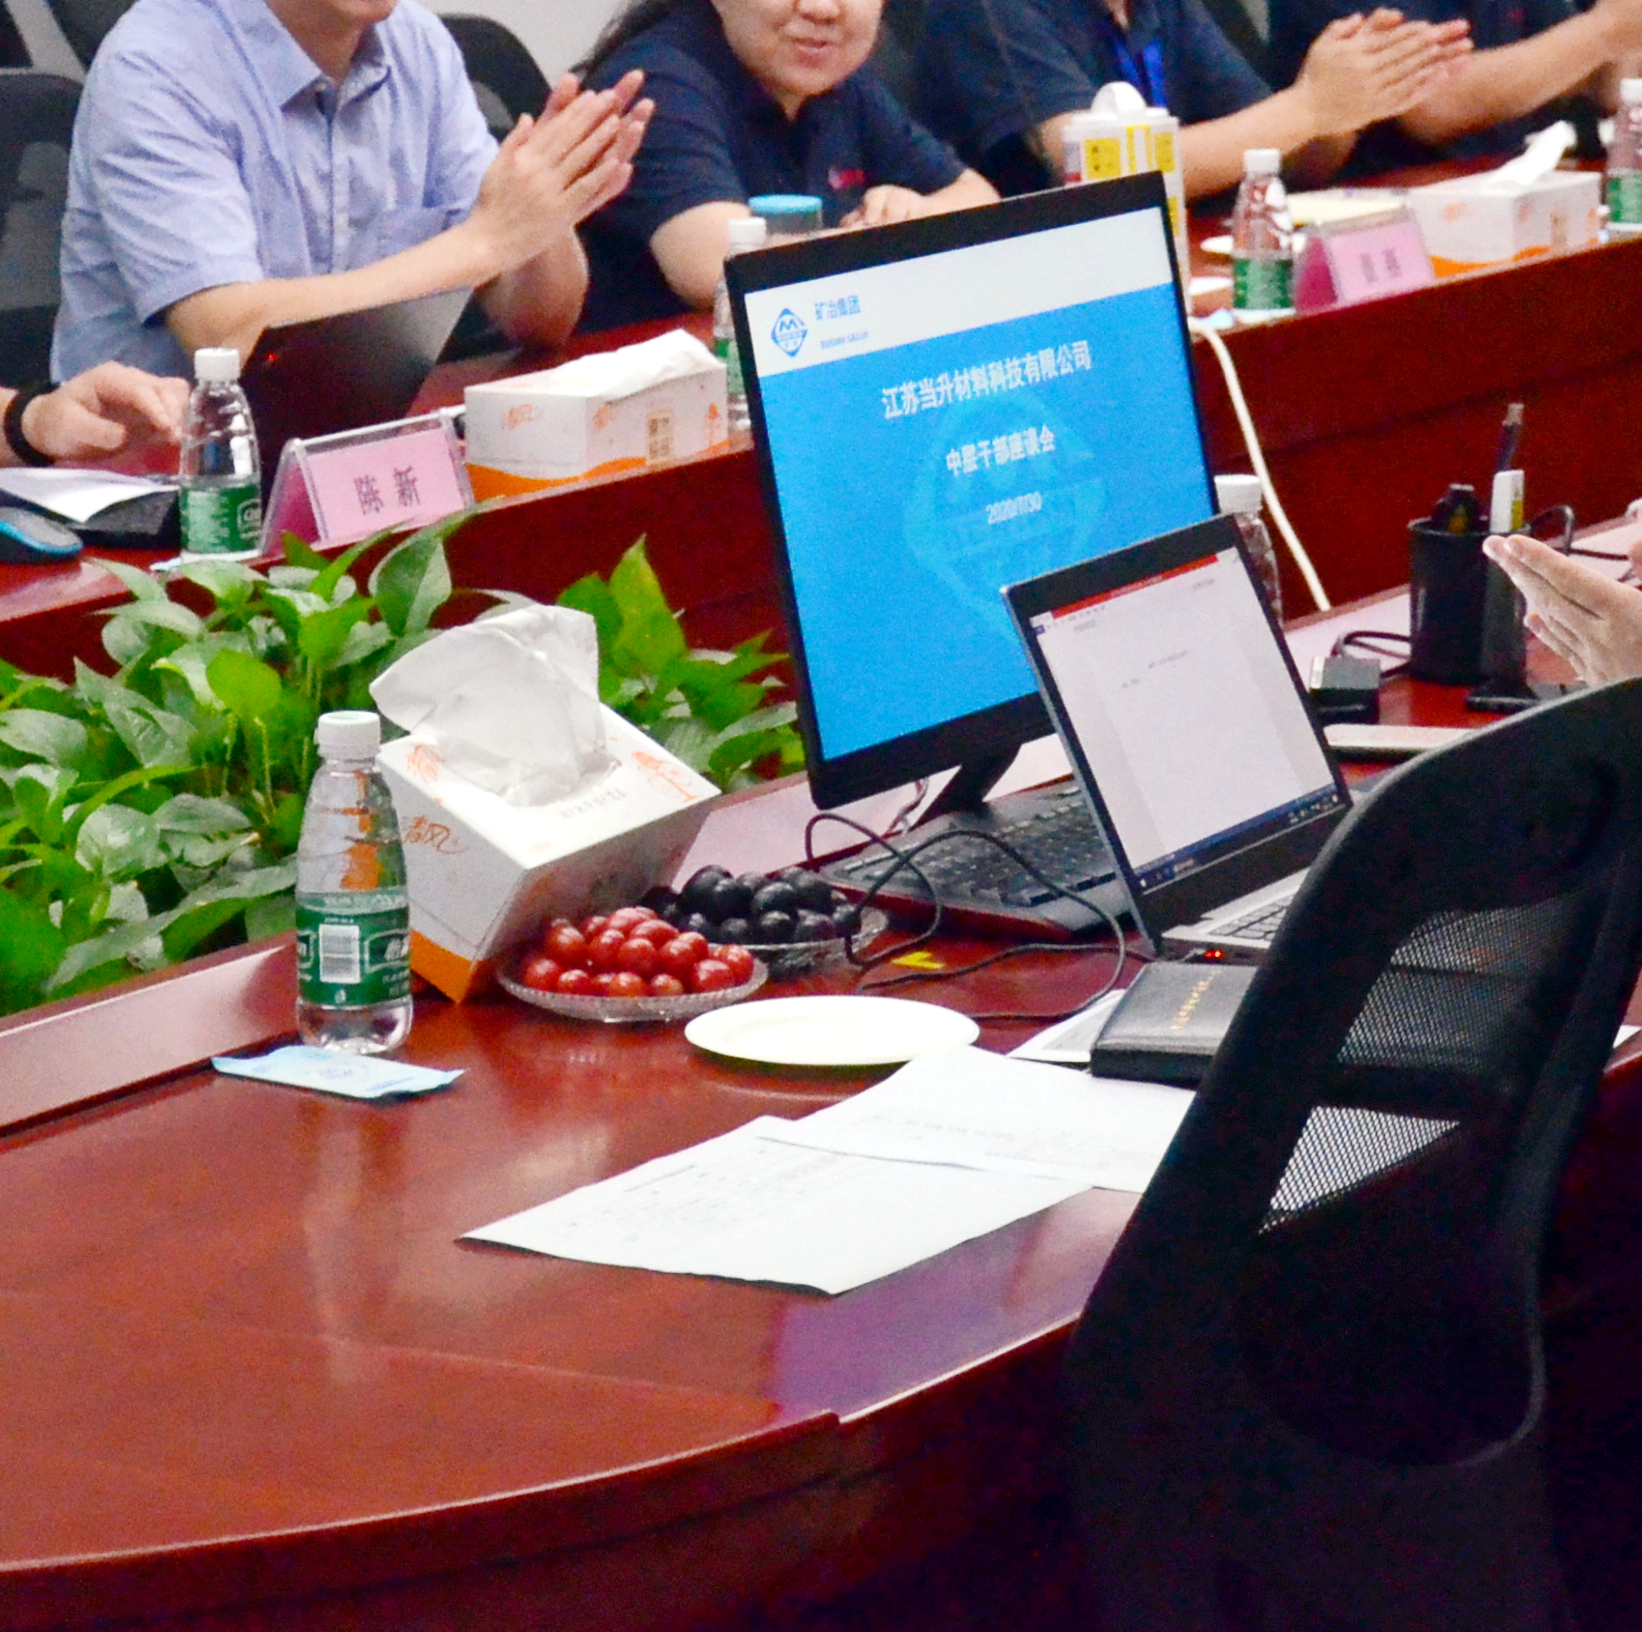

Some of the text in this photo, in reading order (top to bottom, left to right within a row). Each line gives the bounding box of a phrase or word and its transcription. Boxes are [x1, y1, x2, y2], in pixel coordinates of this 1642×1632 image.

[814, 294, 861, 321] 矿冶集团
[881, 339, 1092, 419] 江苏当升材料科技有限公司
[945, 424, 1056, 477] 中层干部座谈会
